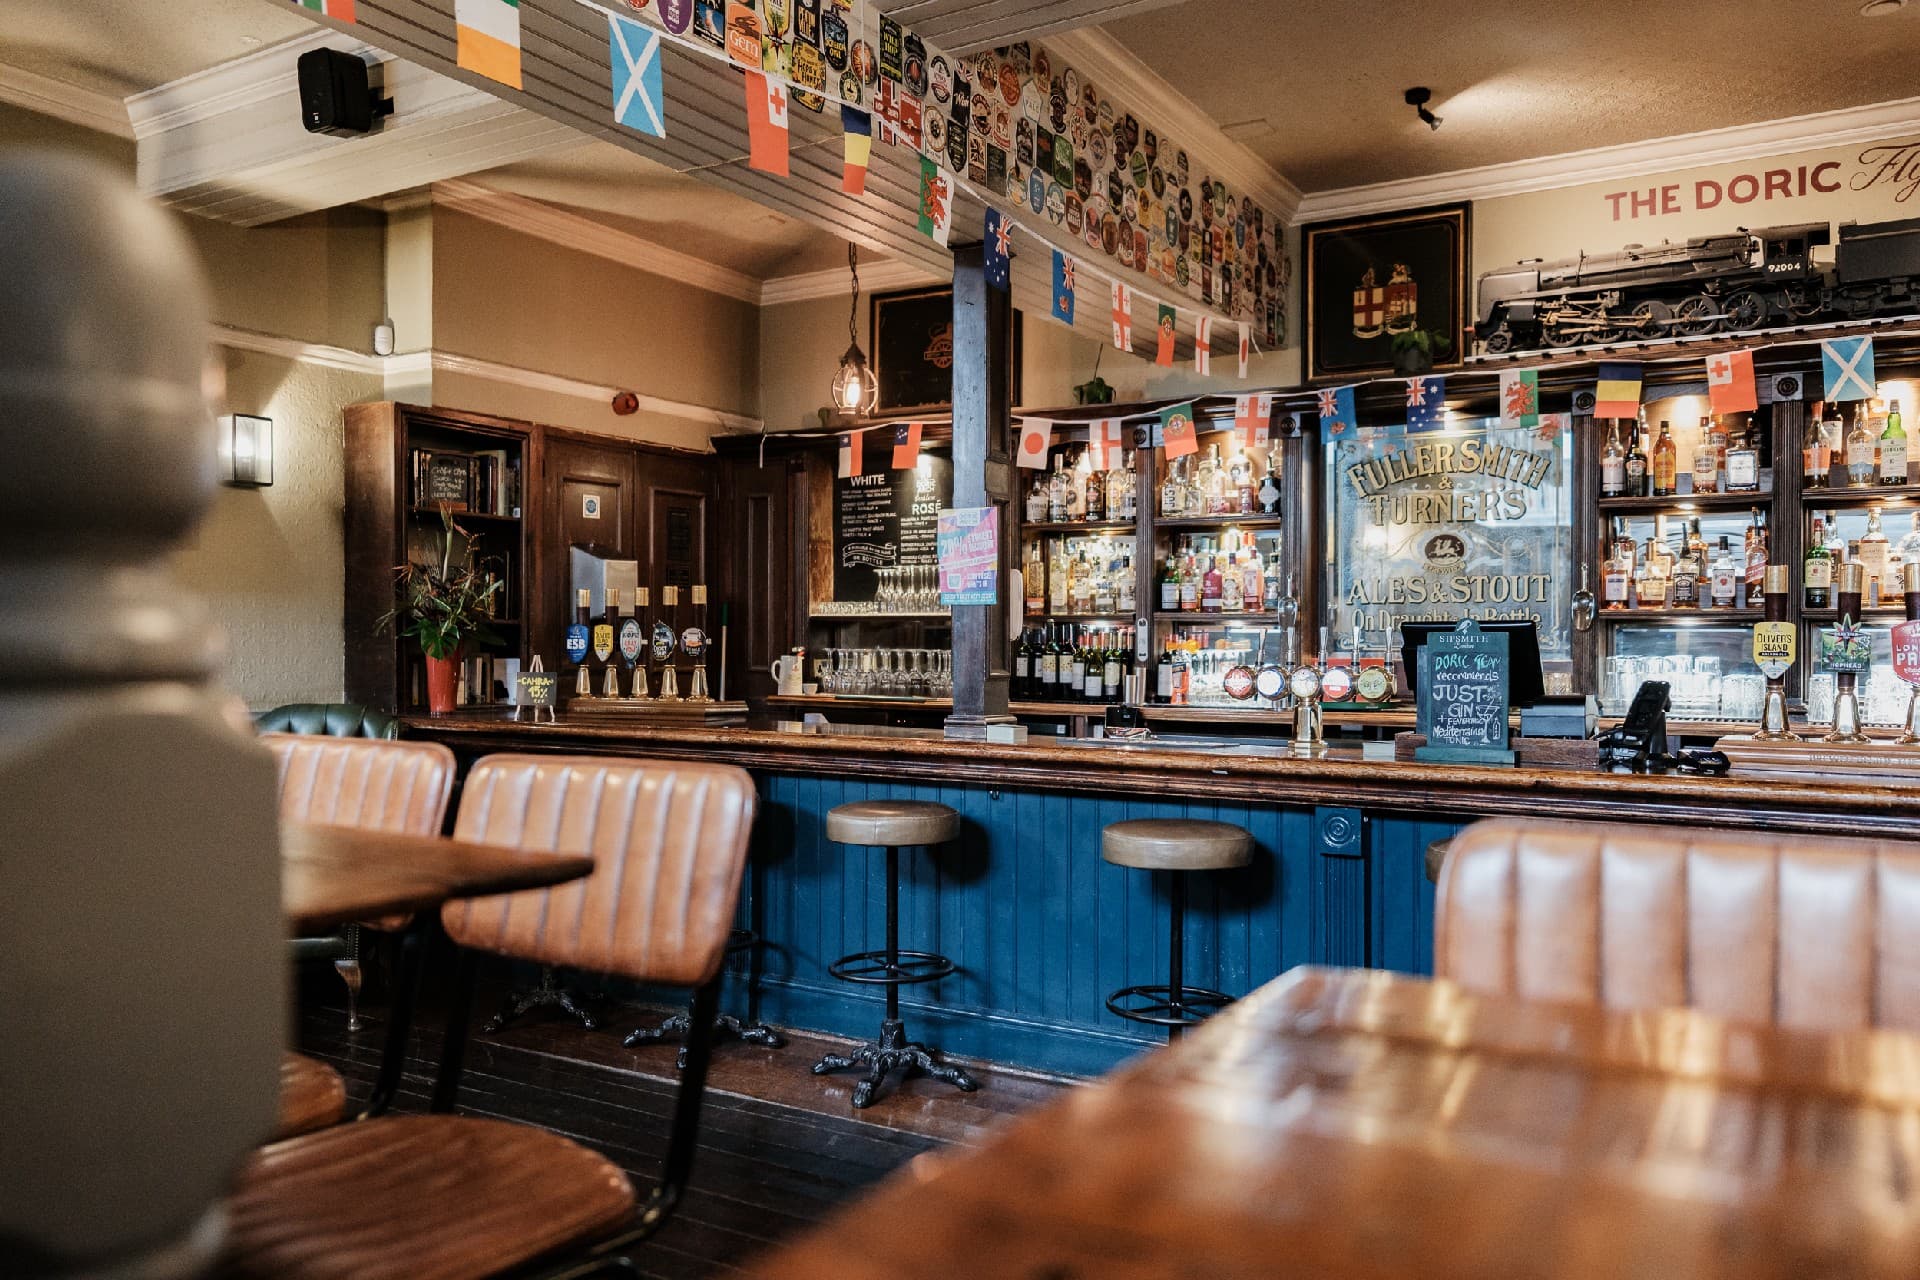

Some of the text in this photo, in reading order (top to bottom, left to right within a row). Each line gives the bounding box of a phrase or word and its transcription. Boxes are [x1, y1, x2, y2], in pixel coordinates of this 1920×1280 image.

[729, 30, 759, 58] Gem
[1604, 184, 1682, 222] THE
[1694, 161, 1842, 210] DORIC
[1768, 262, 1801, 273] 92004
[850, 474, 886, 487] WHITE
[912, 500, 942, 515] ROSÉ
[1346, 577, 1427, 606] ALES
[1450, 574, 1552, 604] STOUT
[1351, 608, 1376, 632] On
[566, 638, 586, 650] ESB
[1756, 633, 1792, 644] OLIVER'S
[1762, 643, 1788, 652] ISLAND
[1435, 653, 1471, 672] DORIC
[1432, 685, 1488, 703] JUST
[1448, 702, 1474, 718] GIN
